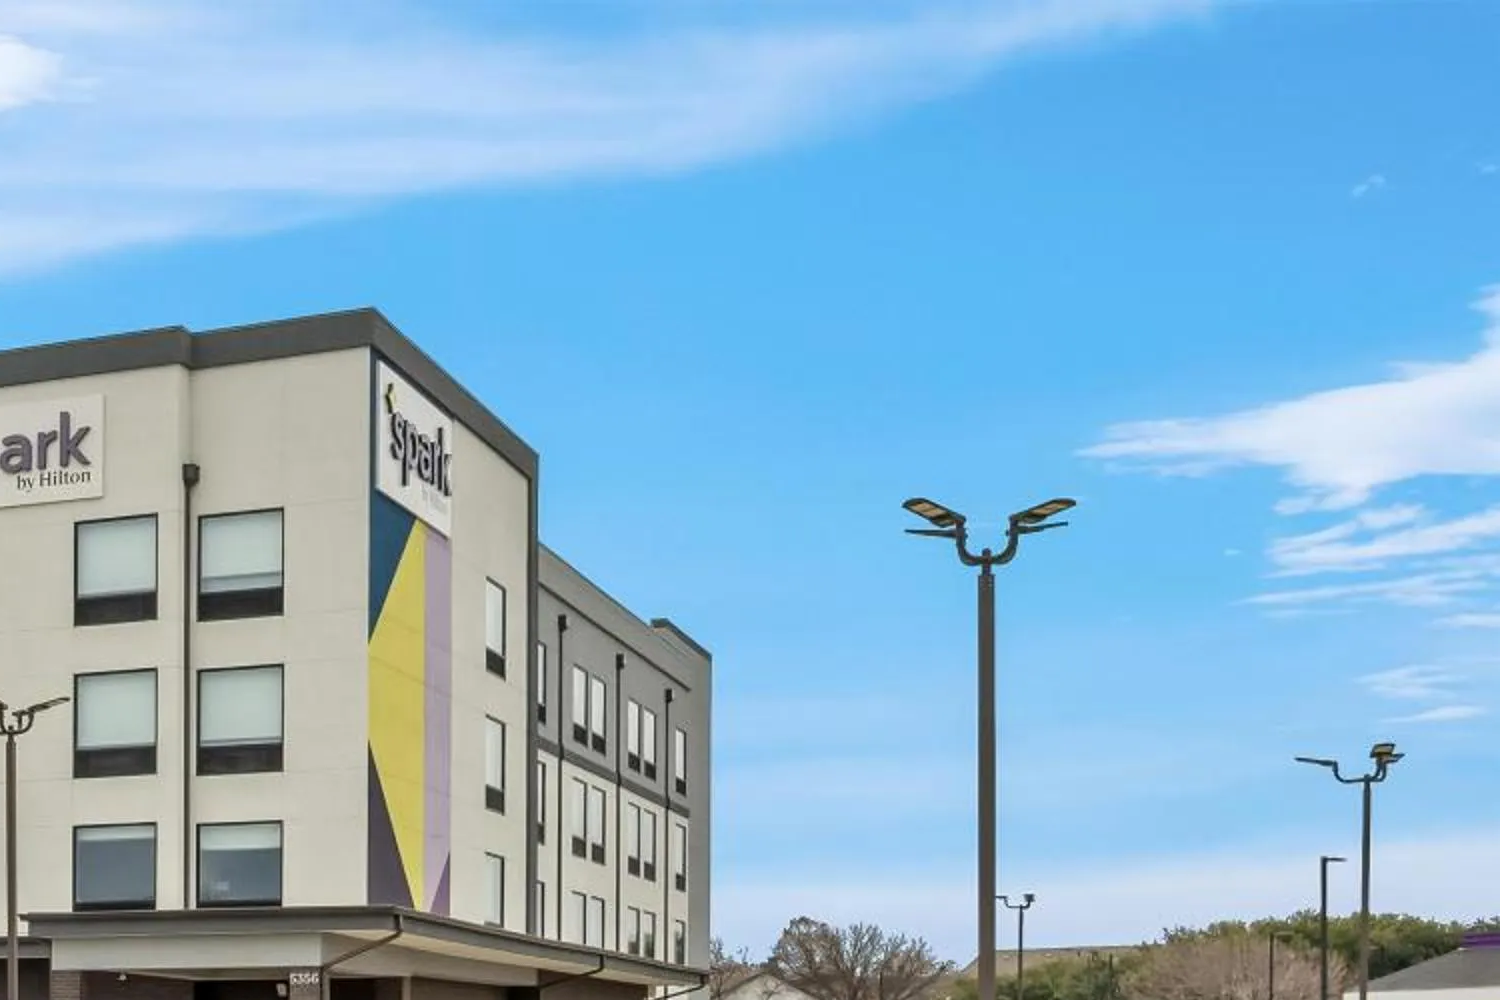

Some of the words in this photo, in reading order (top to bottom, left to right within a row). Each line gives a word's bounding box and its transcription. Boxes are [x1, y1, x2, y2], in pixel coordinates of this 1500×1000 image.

[16, 475, 36, 493] by
[39, 470, 91, 488] Hilton
[390, 412, 452, 497] spark
